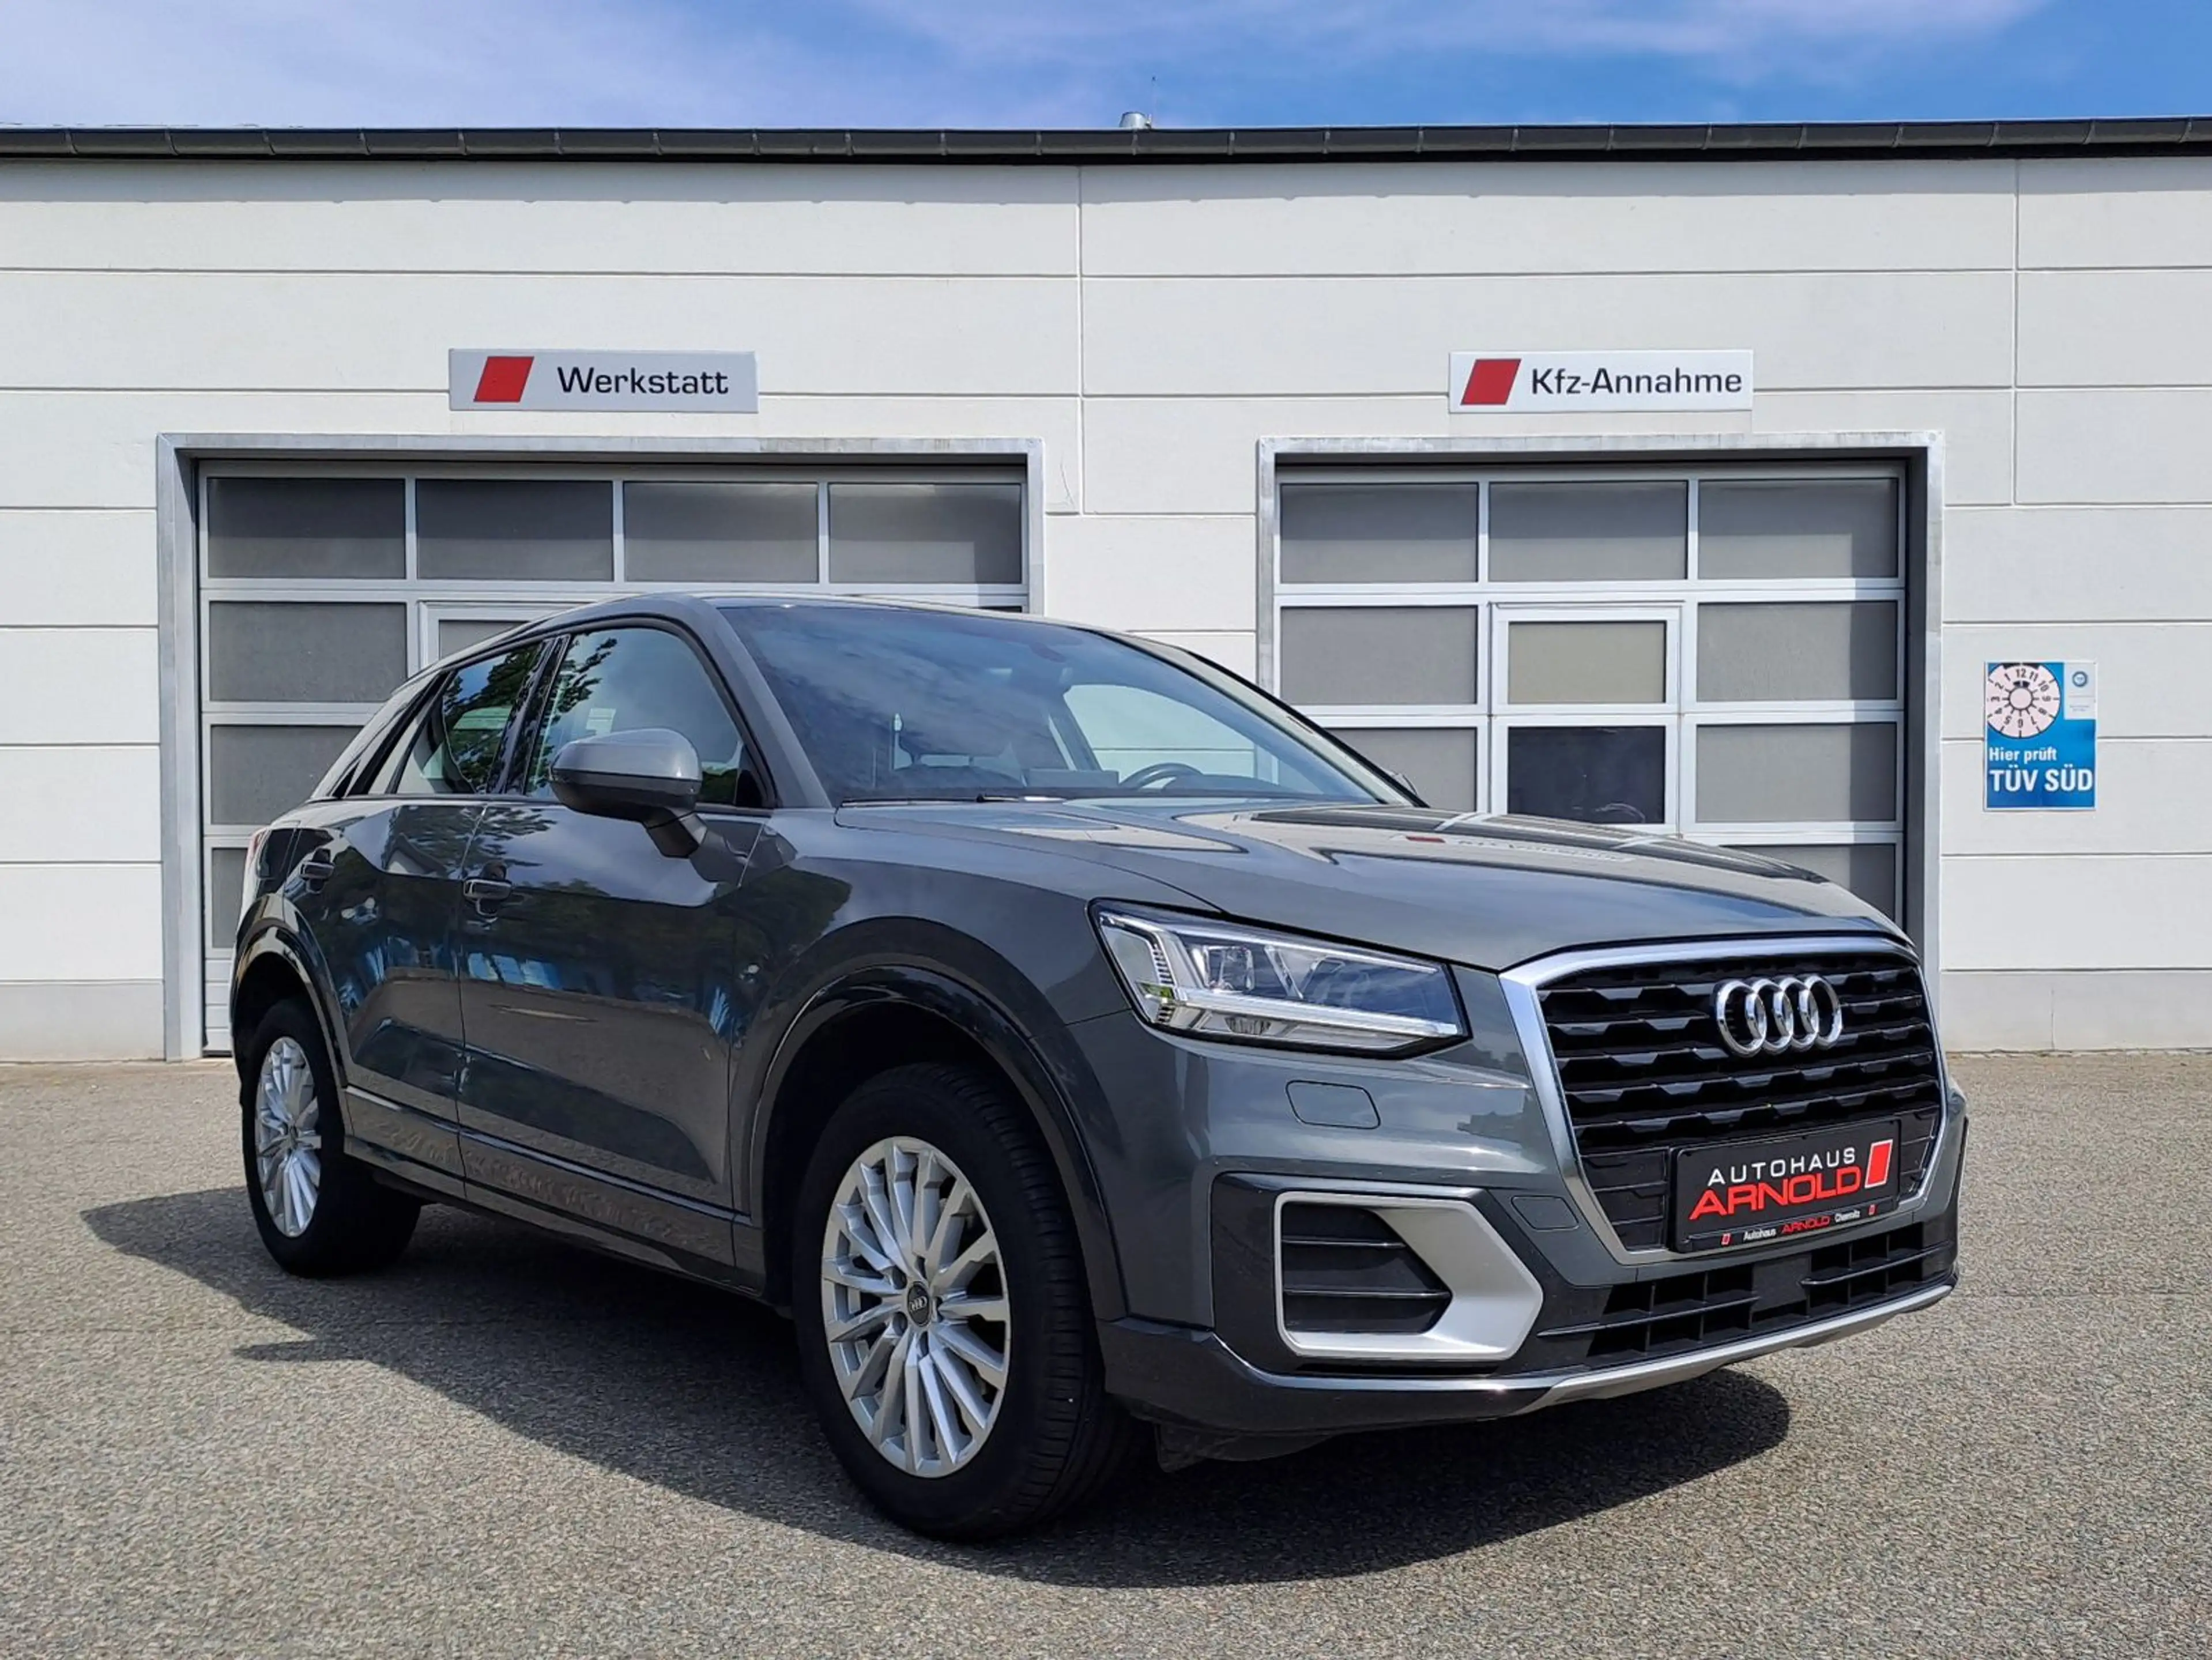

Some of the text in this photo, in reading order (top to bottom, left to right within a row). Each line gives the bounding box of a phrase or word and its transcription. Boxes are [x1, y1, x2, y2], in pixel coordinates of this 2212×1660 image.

[557, 367, 729, 394] Werkstatt
[1531, 368, 1742, 394] Kfz-Annahme
[2004, 673, 2011, 681] 1
[2015, 668, 2026, 678] 12
[2029, 671, 2038, 681] 11
[1995, 682, 2004, 690] 2
[2038, 680, 2049, 692] 10
[2003, 715, 2013, 725] 5
[1989, 746, 2058, 764] Hier prüft
[1989, 763, 2093, 792] TÜV SÜD
[1708, 1148, 1856, 1186] AUTOHAUS
[1689, 1165, 1863, 1220] ARNOLD
[1743, 1228, 1777, 1242] Autohaus
[1781, 1215, 1831, 1235] ARNOLD
